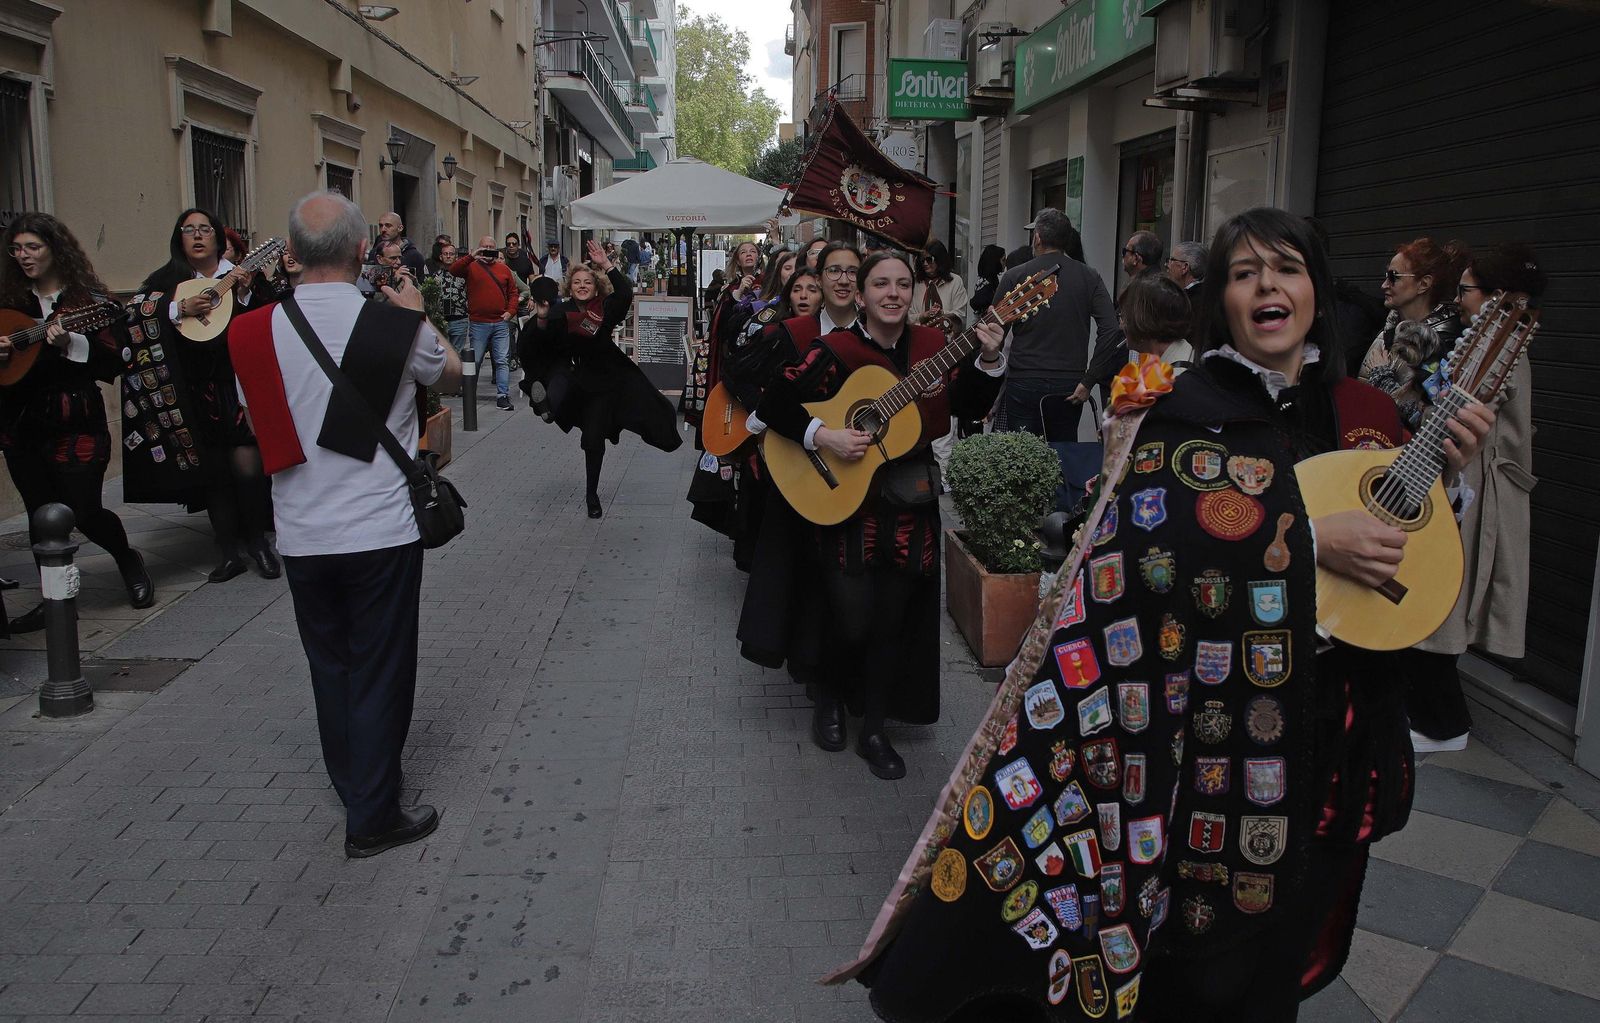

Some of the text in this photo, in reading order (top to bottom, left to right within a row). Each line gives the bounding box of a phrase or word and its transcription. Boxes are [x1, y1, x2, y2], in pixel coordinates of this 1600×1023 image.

[1051, 0, 1096, 84] Santiveri
[895, 70, 969, 98] Santiveri
[829, 188, 894, 230] SALAMANCA
[1194, 576, 1230, 585] BRUSSELS
[1058, 640, 1089, 654] CUENCA
[1068, 832, 1092, 845] ITALIA
